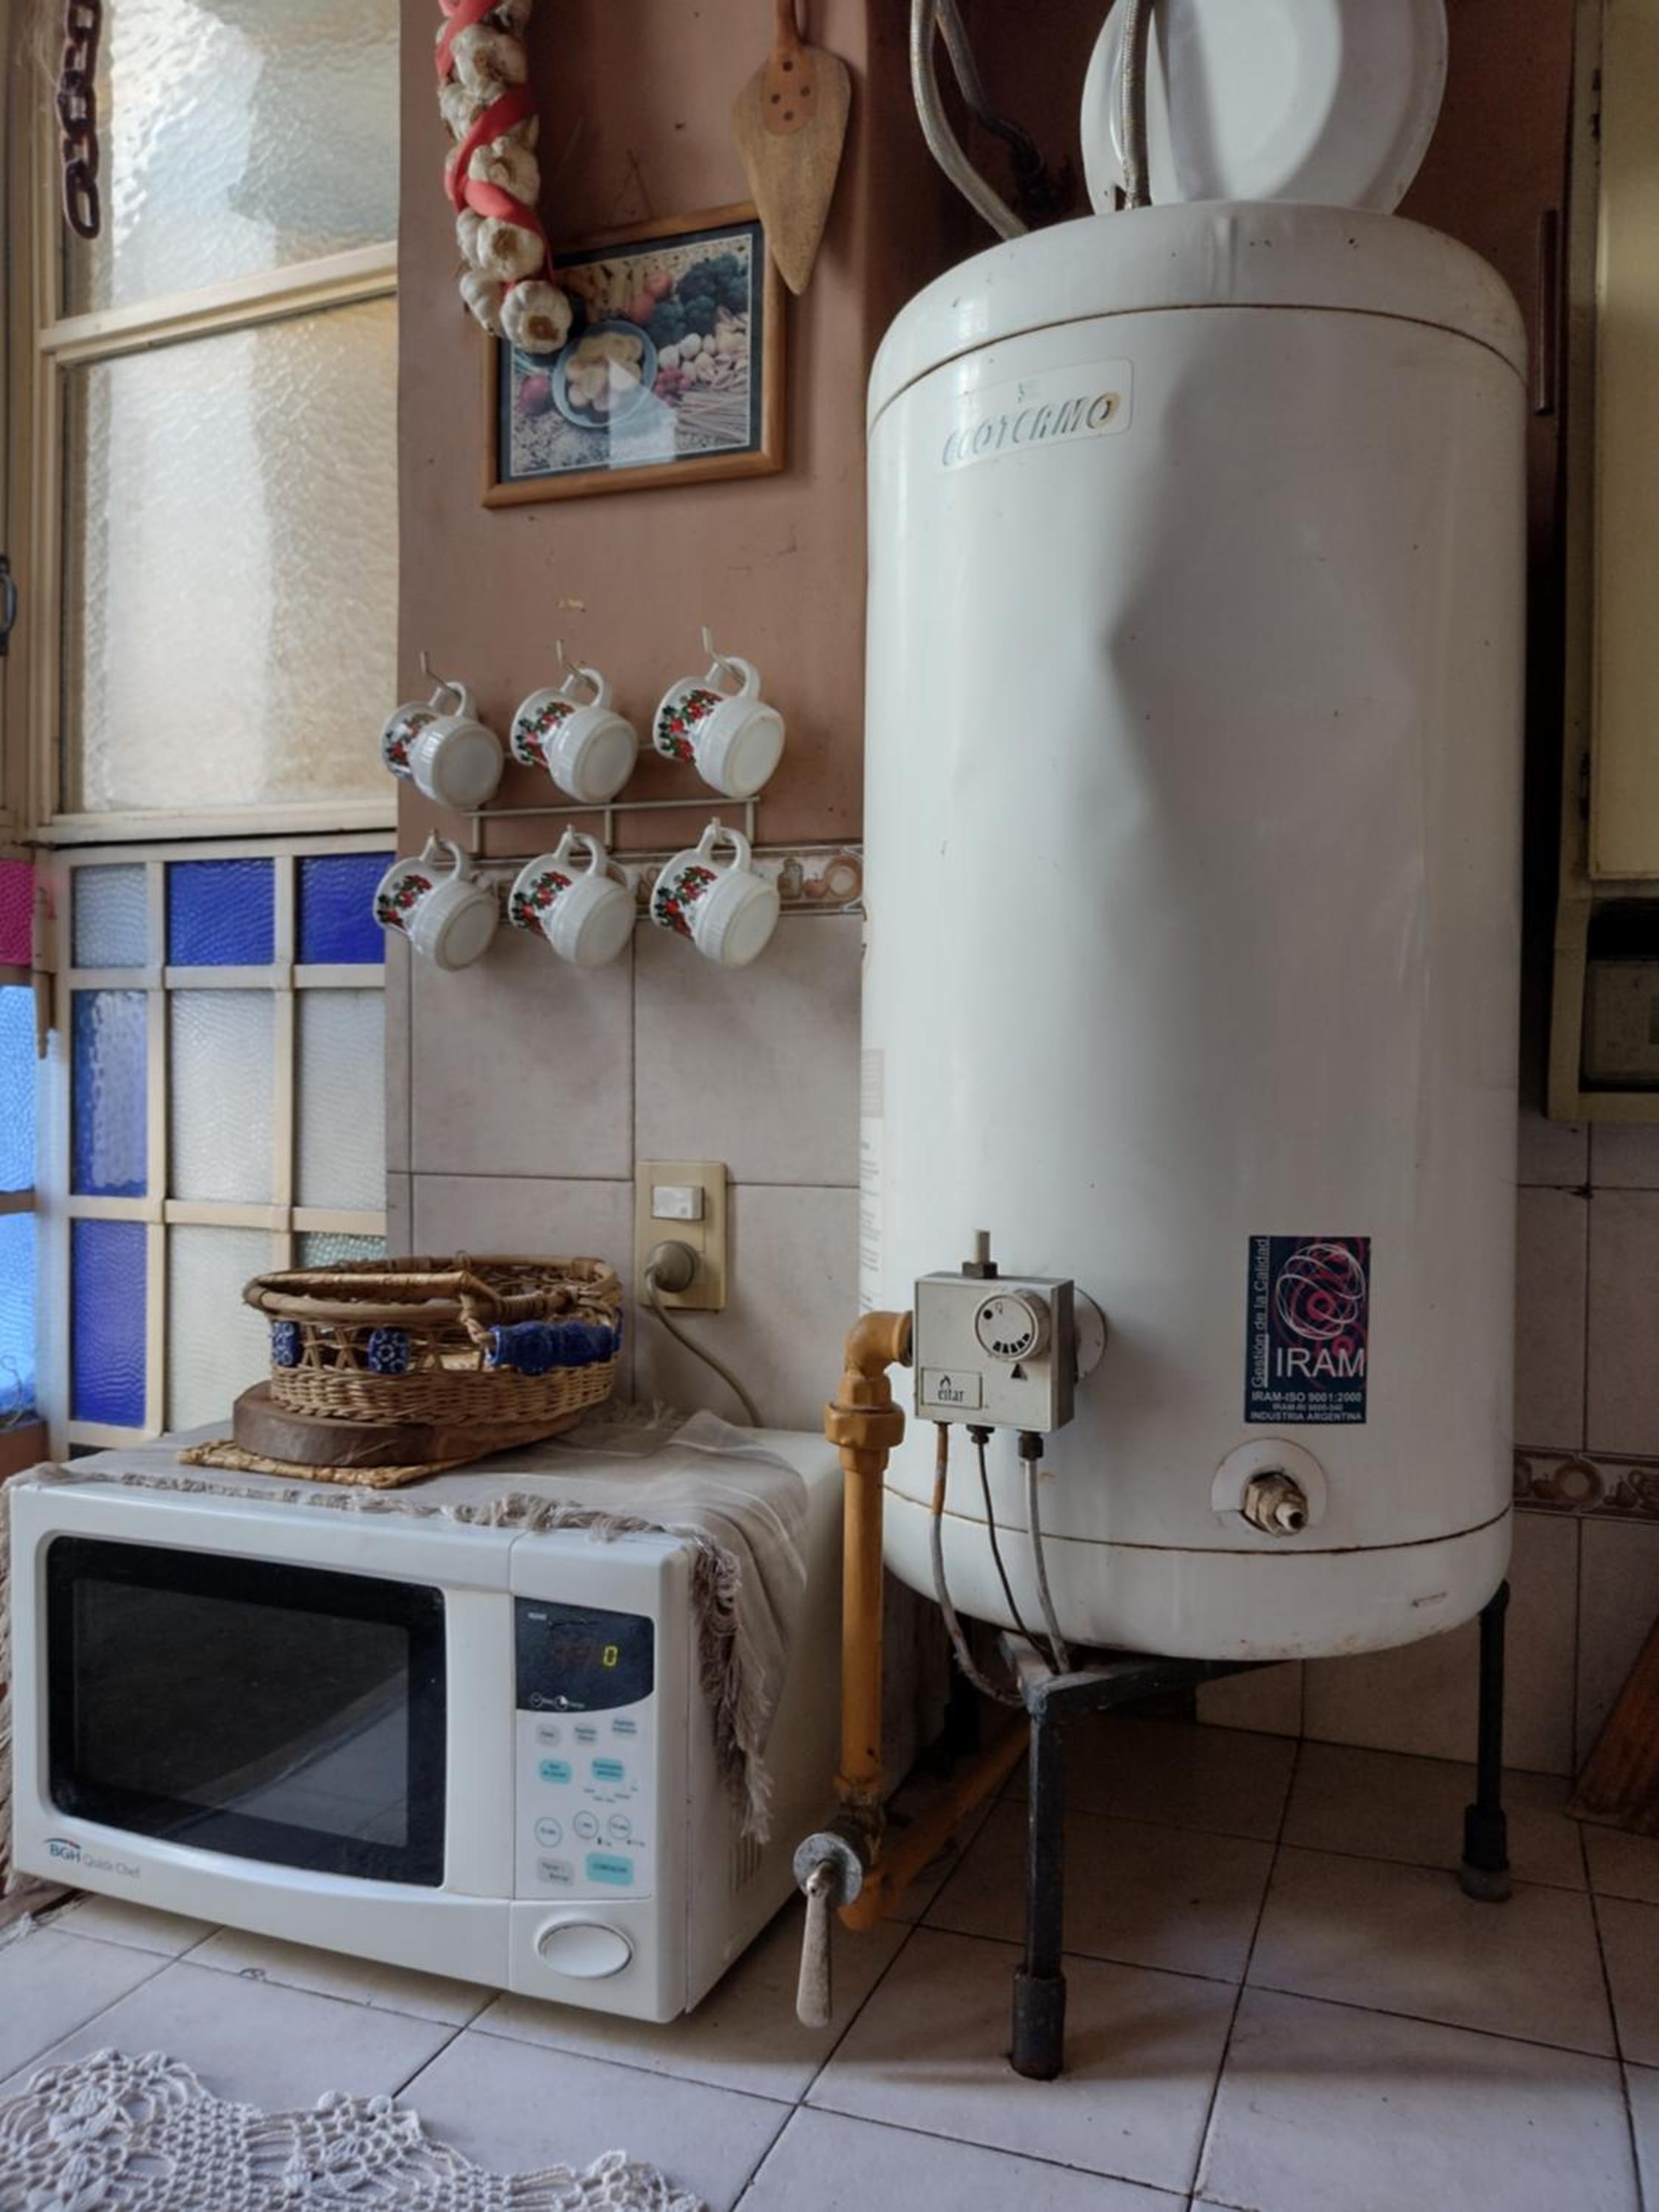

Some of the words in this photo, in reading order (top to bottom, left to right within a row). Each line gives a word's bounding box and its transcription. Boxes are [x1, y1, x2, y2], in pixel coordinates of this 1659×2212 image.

[1253, 1238, 1269, 1291] Calidad
[1276, 1348, 1364, 1377] IRAM
[603, 1645, 618, 1667] 0
